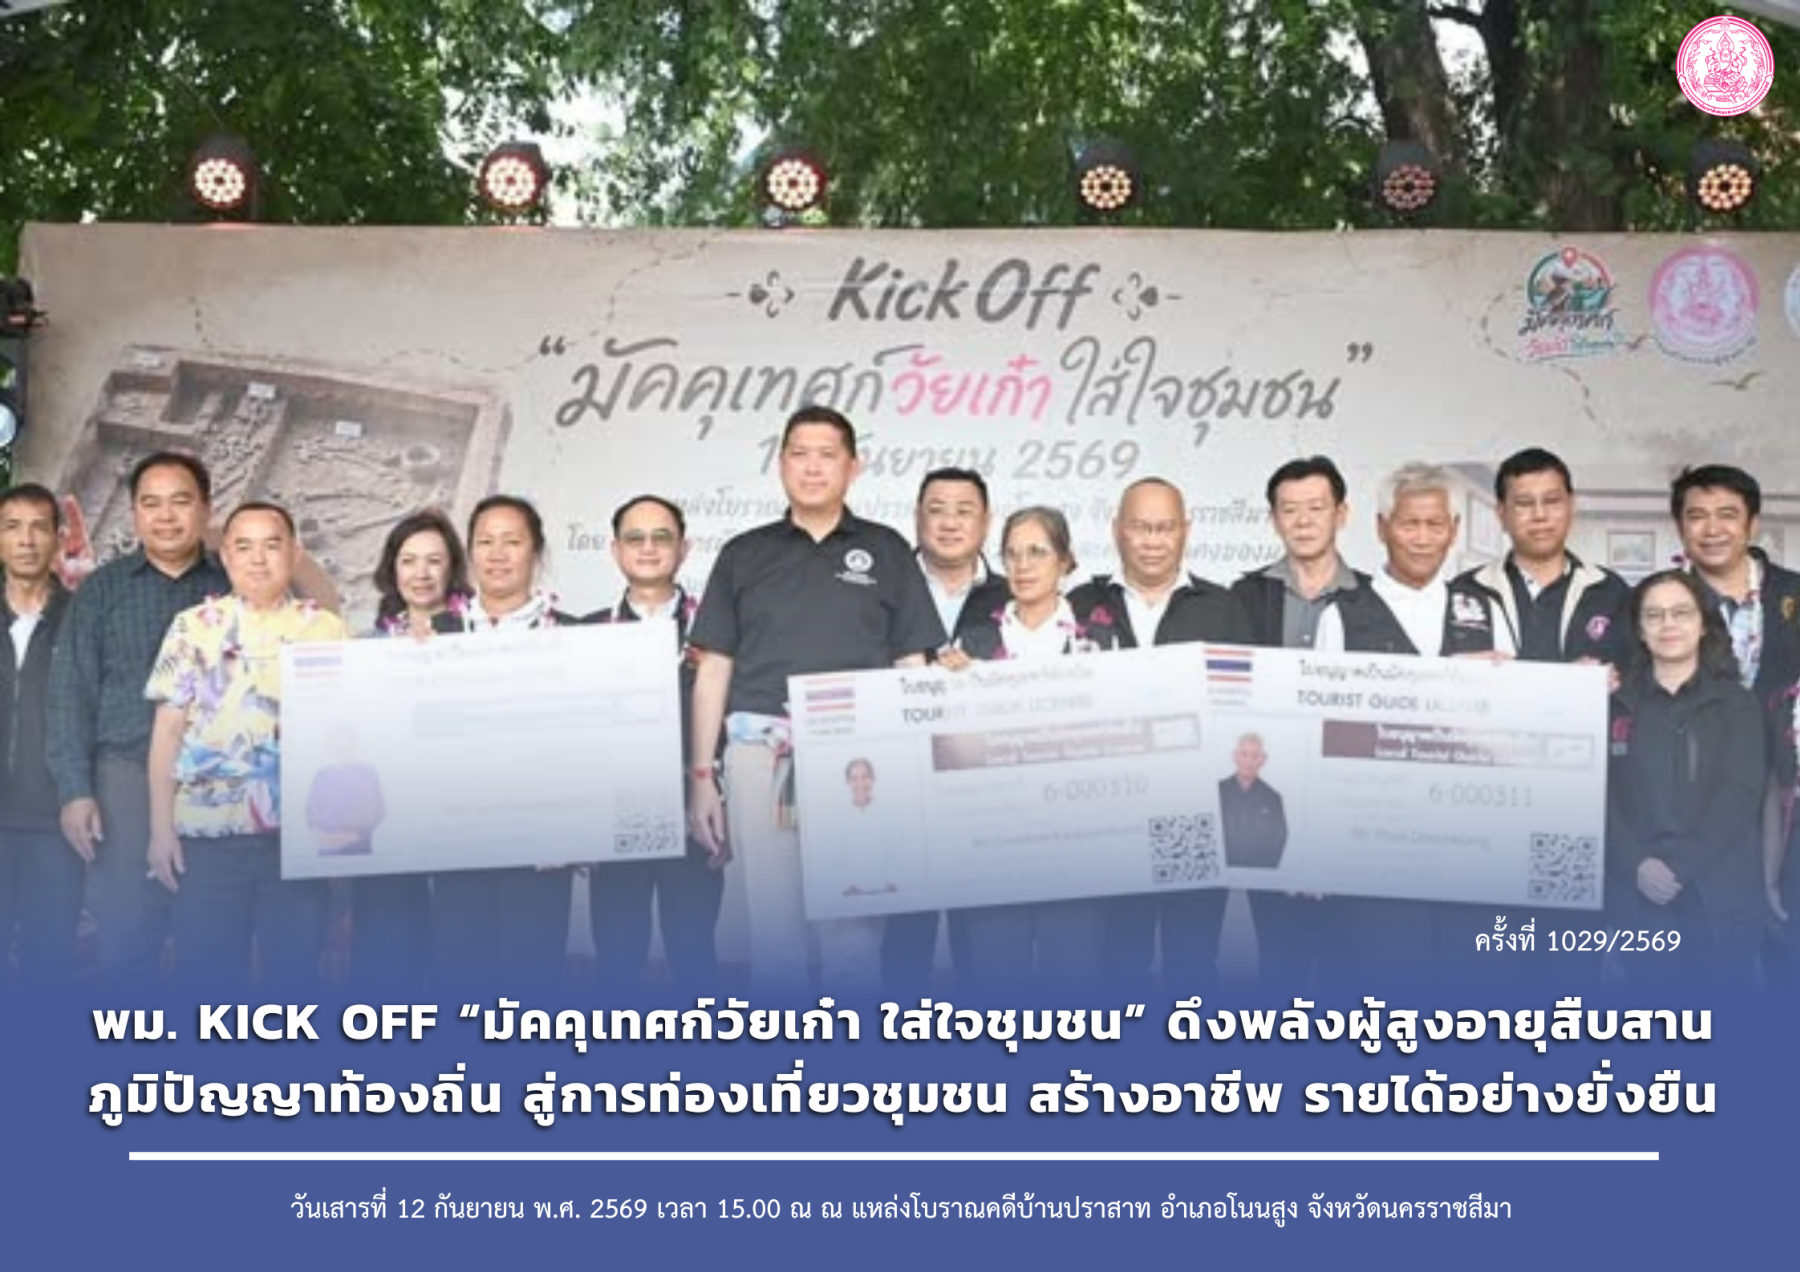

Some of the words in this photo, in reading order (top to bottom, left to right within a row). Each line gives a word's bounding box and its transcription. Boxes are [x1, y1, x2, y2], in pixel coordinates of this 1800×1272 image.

[827, 256, 971, 323] Kick
[974, 257, 1101, 330] Off
[1012, 437, 1142, 481] 2569
[1297, 690, 1364, 709] TOURIST
[1369, 694, 1419, 711] GUIDE
